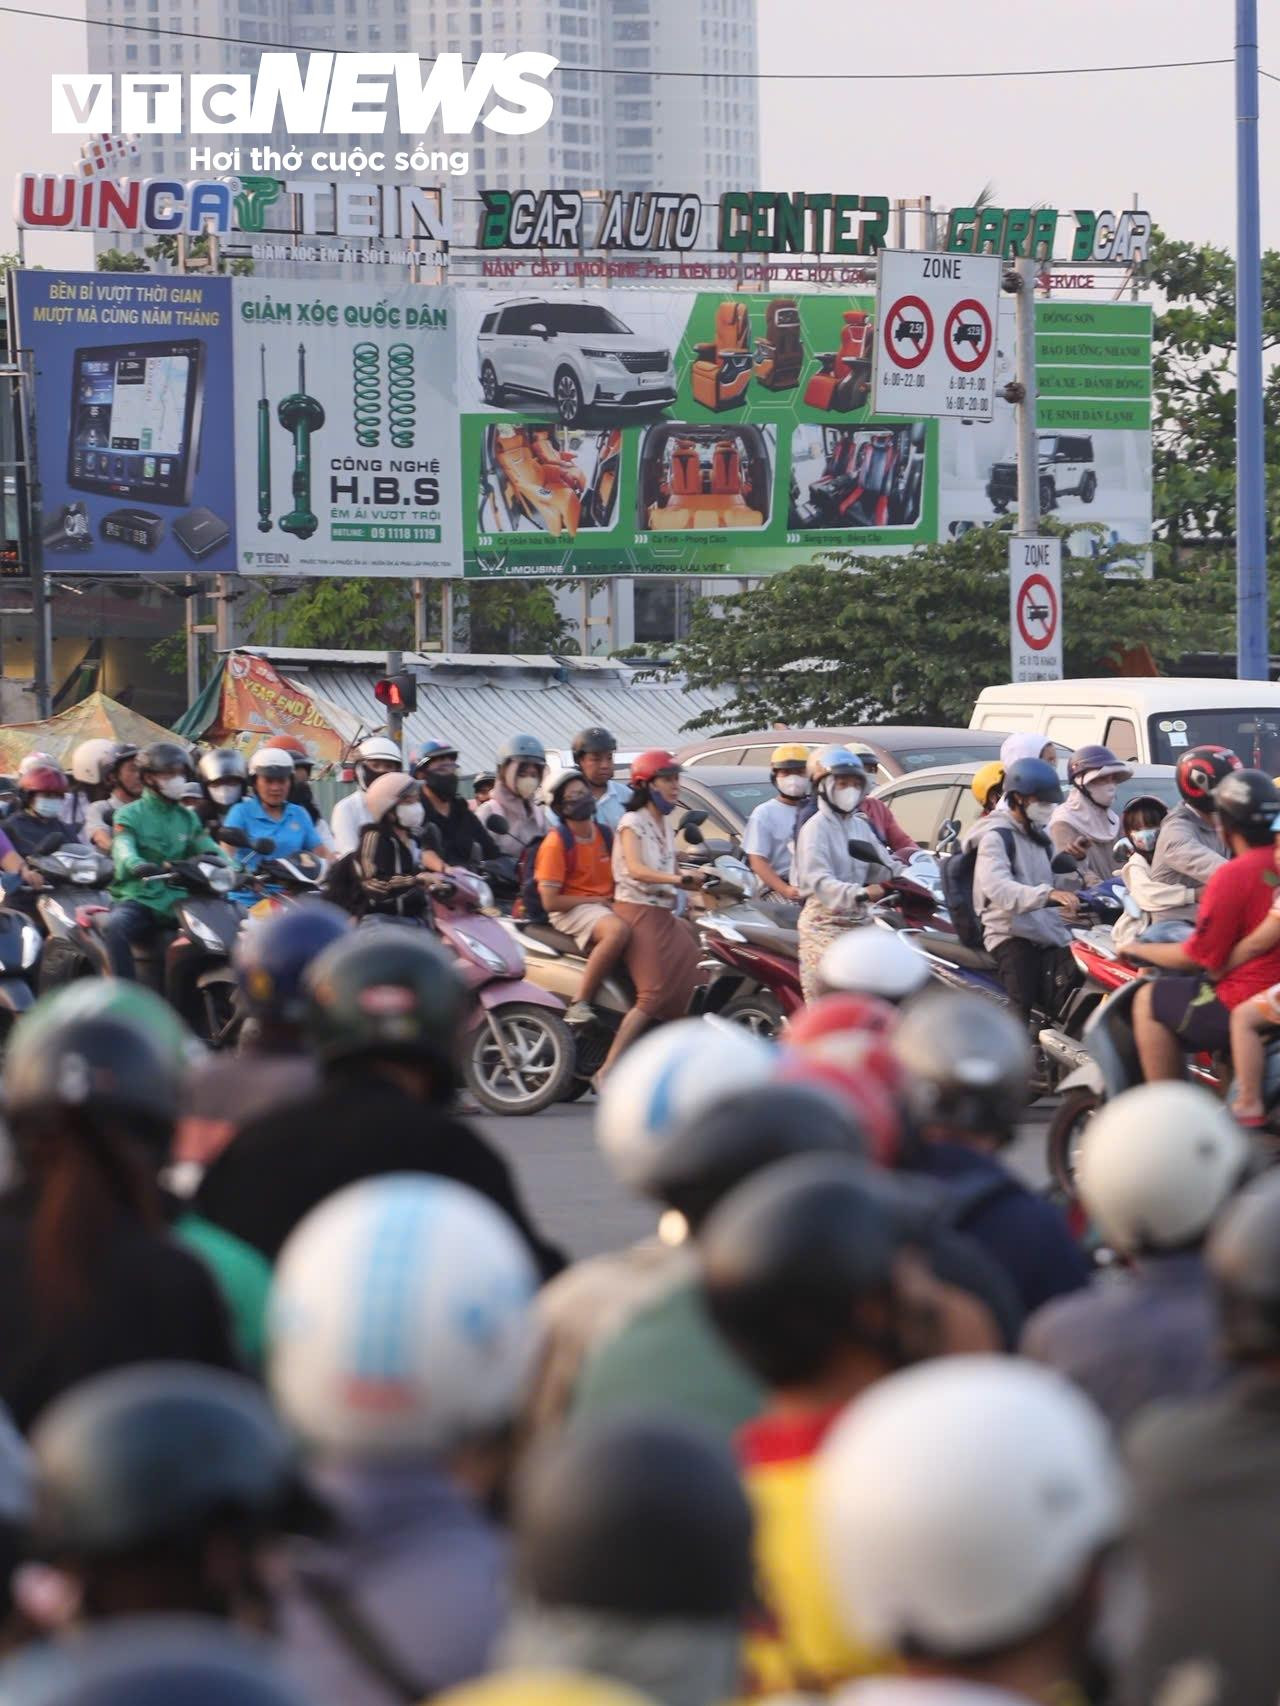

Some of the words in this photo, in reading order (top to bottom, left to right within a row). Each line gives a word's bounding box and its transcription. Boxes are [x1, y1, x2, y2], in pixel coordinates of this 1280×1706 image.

[284, 181, 451, 240] TEIN
[596, 190, 701, 250] AUTO
[718, 192, 890, 256] CENTER
[945, 207, 1059, 262] GARA
[922, 258, 962, 280] ZONE
[49, 279, 76, 300] BỀN
[97, 286, 133, 304] VƯỢT
[137, 284, 167, 302] THỜI
[171, 288, 202, 304] GIAN
[33, 307, 74, 326] MƯỢT
[77, 305, 98, 324] MÀ
[101, 306, 138, 325] CÙNG
[141, 305, 172, 325] NĂM
[176, 308, 220, 327] THÁNG
[241, 295, 292, 322] GIẢM
[297, 299, 339, 325] XÓC
[344, 299, 401, 327] QUỐC
[405, 303, 448, 328] DÂN
[330, 456, 382, 472] CÔNG
[390, 458, 440, 476] NGHỆ
[330, 476, 440, 506] H.B.S
[331, 508, 350, 518] ÊM
[256, 552, 290, 564] TEIN
[1024, 544, 1050, 567] ZONE
[505, 565, 564, 575] LIMOUSINE
[243, 678, 276, 702] YEAR
[276, 694, 304, 717] END
